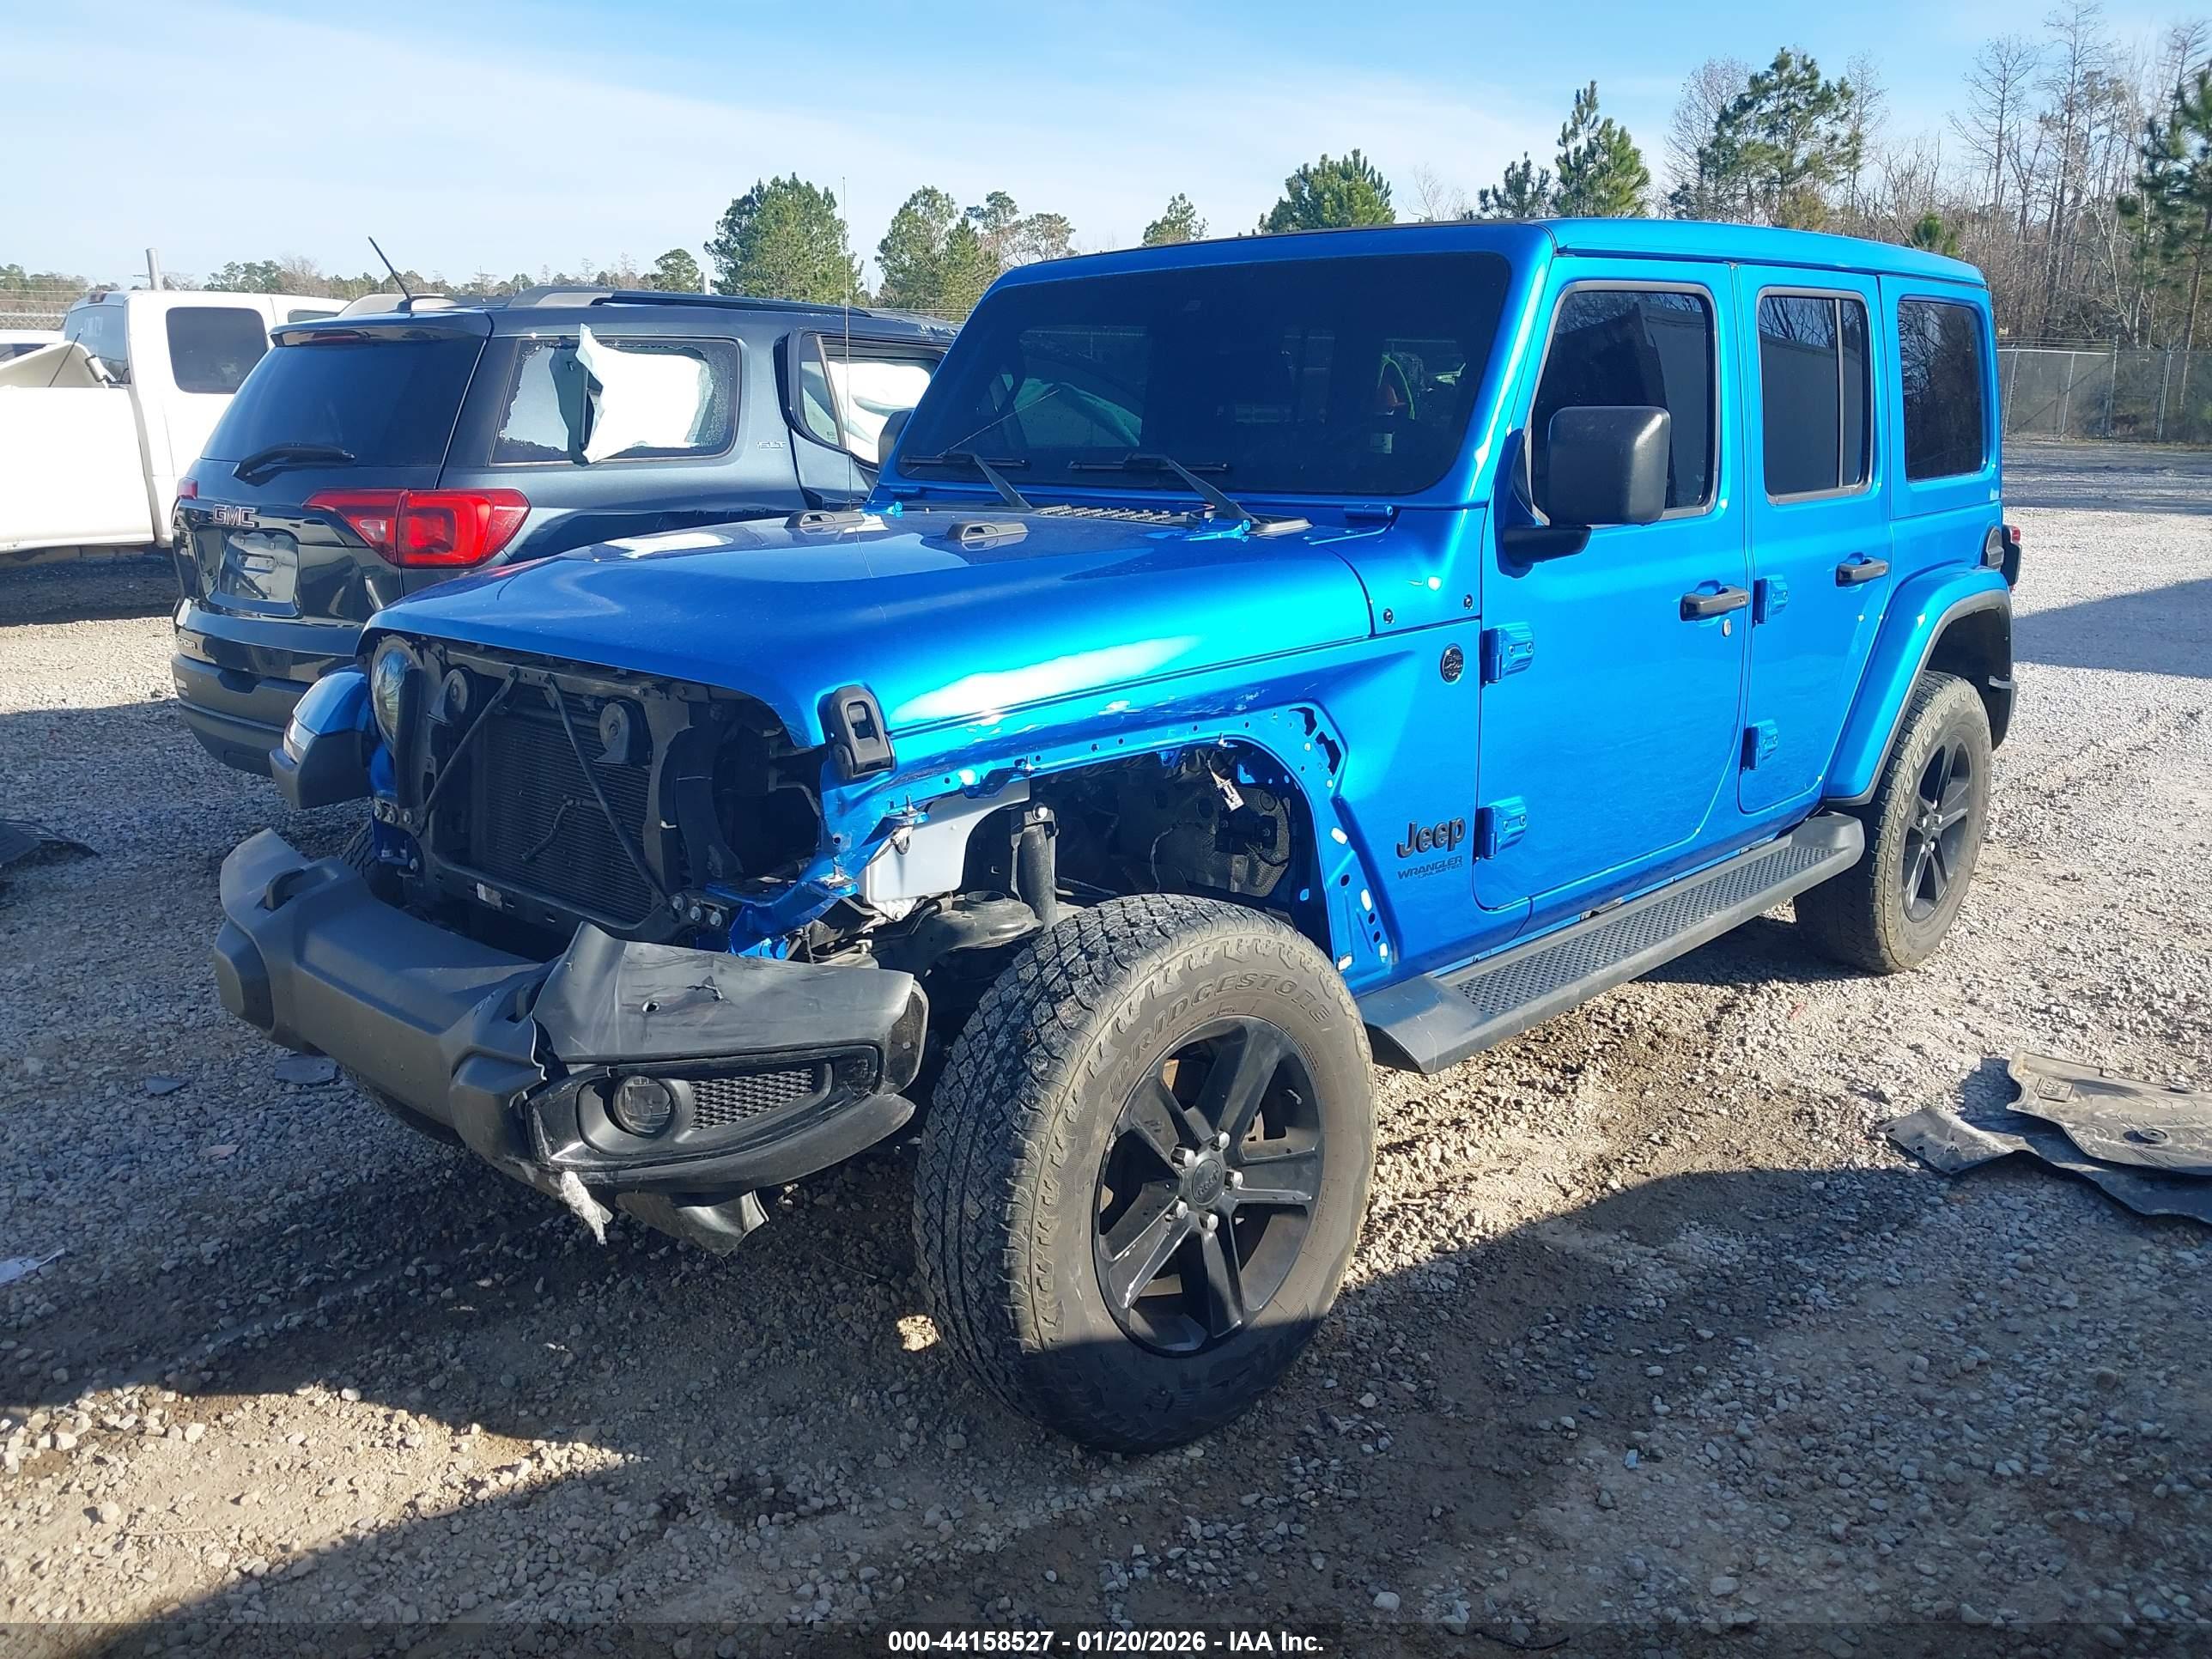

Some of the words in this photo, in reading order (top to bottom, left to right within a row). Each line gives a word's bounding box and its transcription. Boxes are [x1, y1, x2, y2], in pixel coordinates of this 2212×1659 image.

[213, 503, 258, 527] GMC
[1396, 817, 1466, 858] Jeep
[1397, 855, 1463, 879] WRANGLER
[1418, 863, 1463, 879] UNLIMITED
